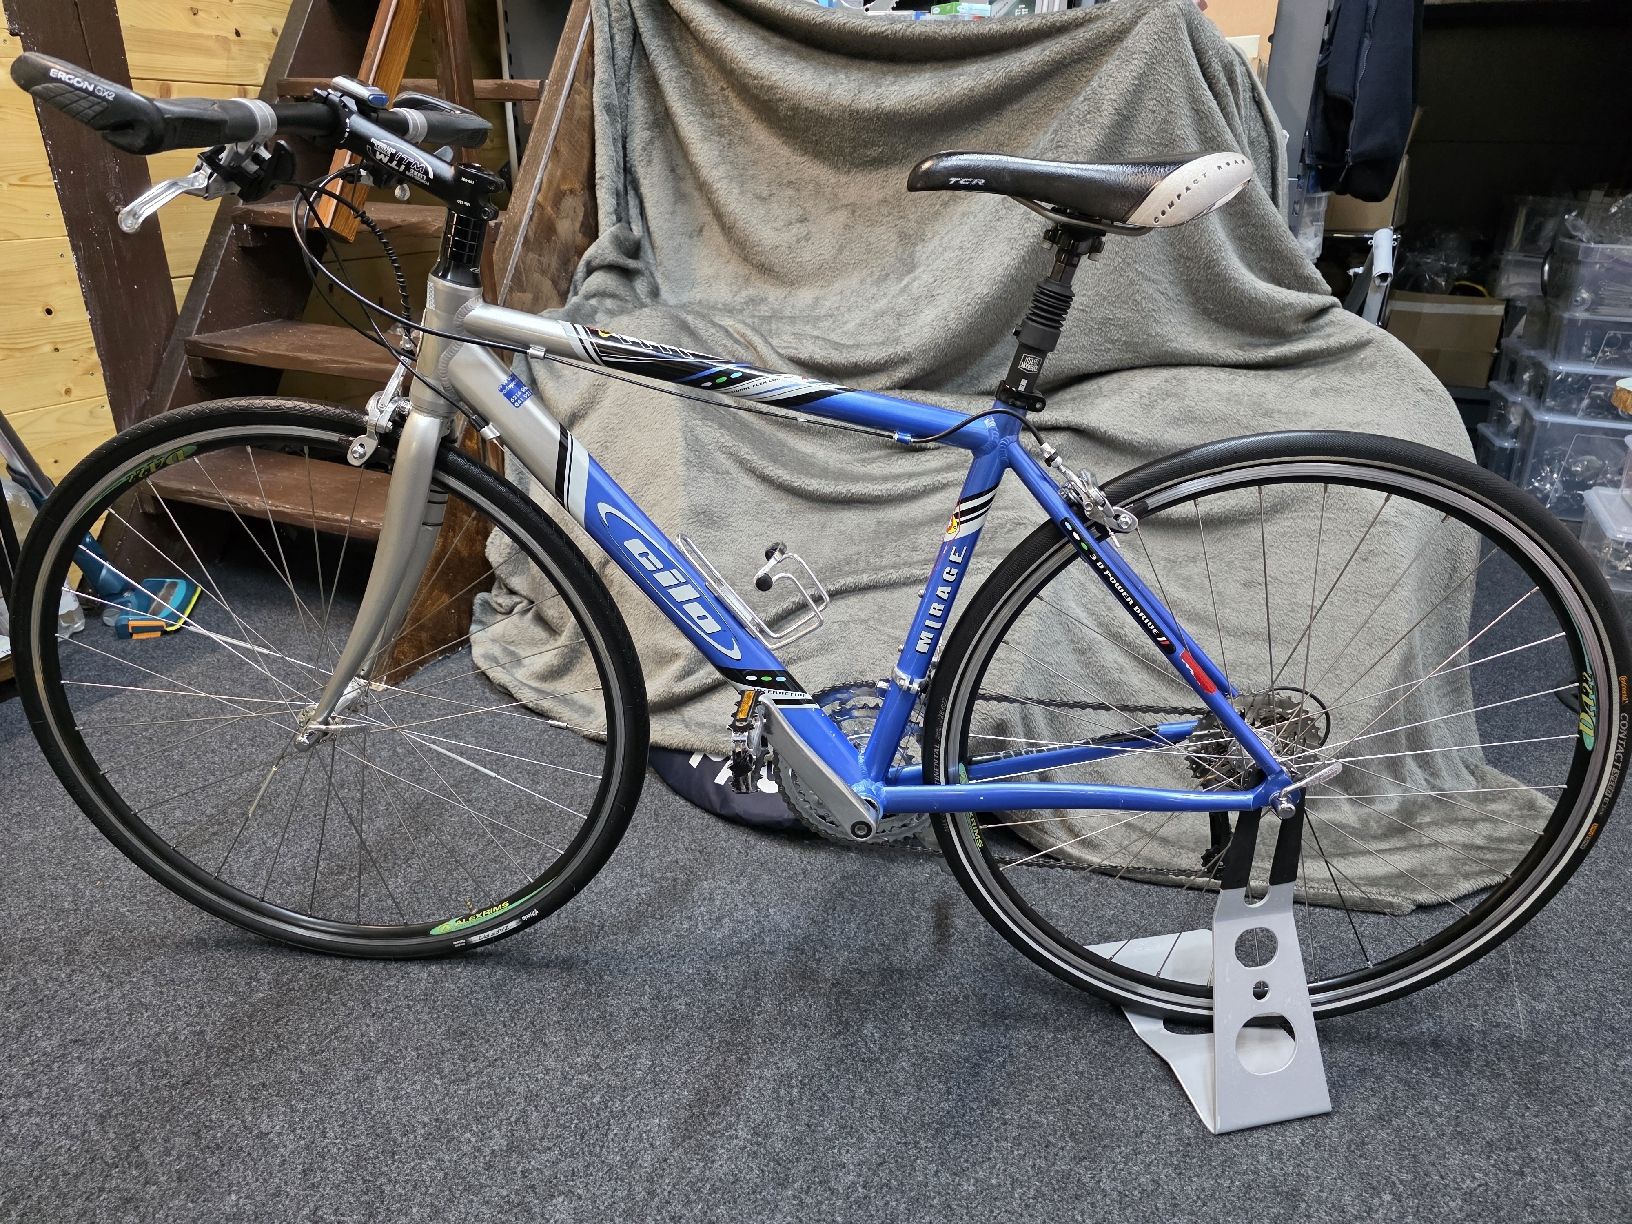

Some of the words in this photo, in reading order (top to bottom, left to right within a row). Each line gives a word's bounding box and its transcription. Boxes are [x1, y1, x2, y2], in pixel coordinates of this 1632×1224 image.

[49, 68, 95, 92] ERGON
[94, 86, 116, 101] GX2
[948, 177, 986, 186] TCR
[1153, 172, 1207, 224] COMPACT
[624, 538, 722, 635] cilo
[915, 546, 968, 655] MIRAGE
[1104, 569, 1135, 606] POWER
[1133, 605, 1160, 636] DRIVE
[1614, 713, 1629, 769] CONTACT
[454, 900, 510, 926] ALEXRIMS
